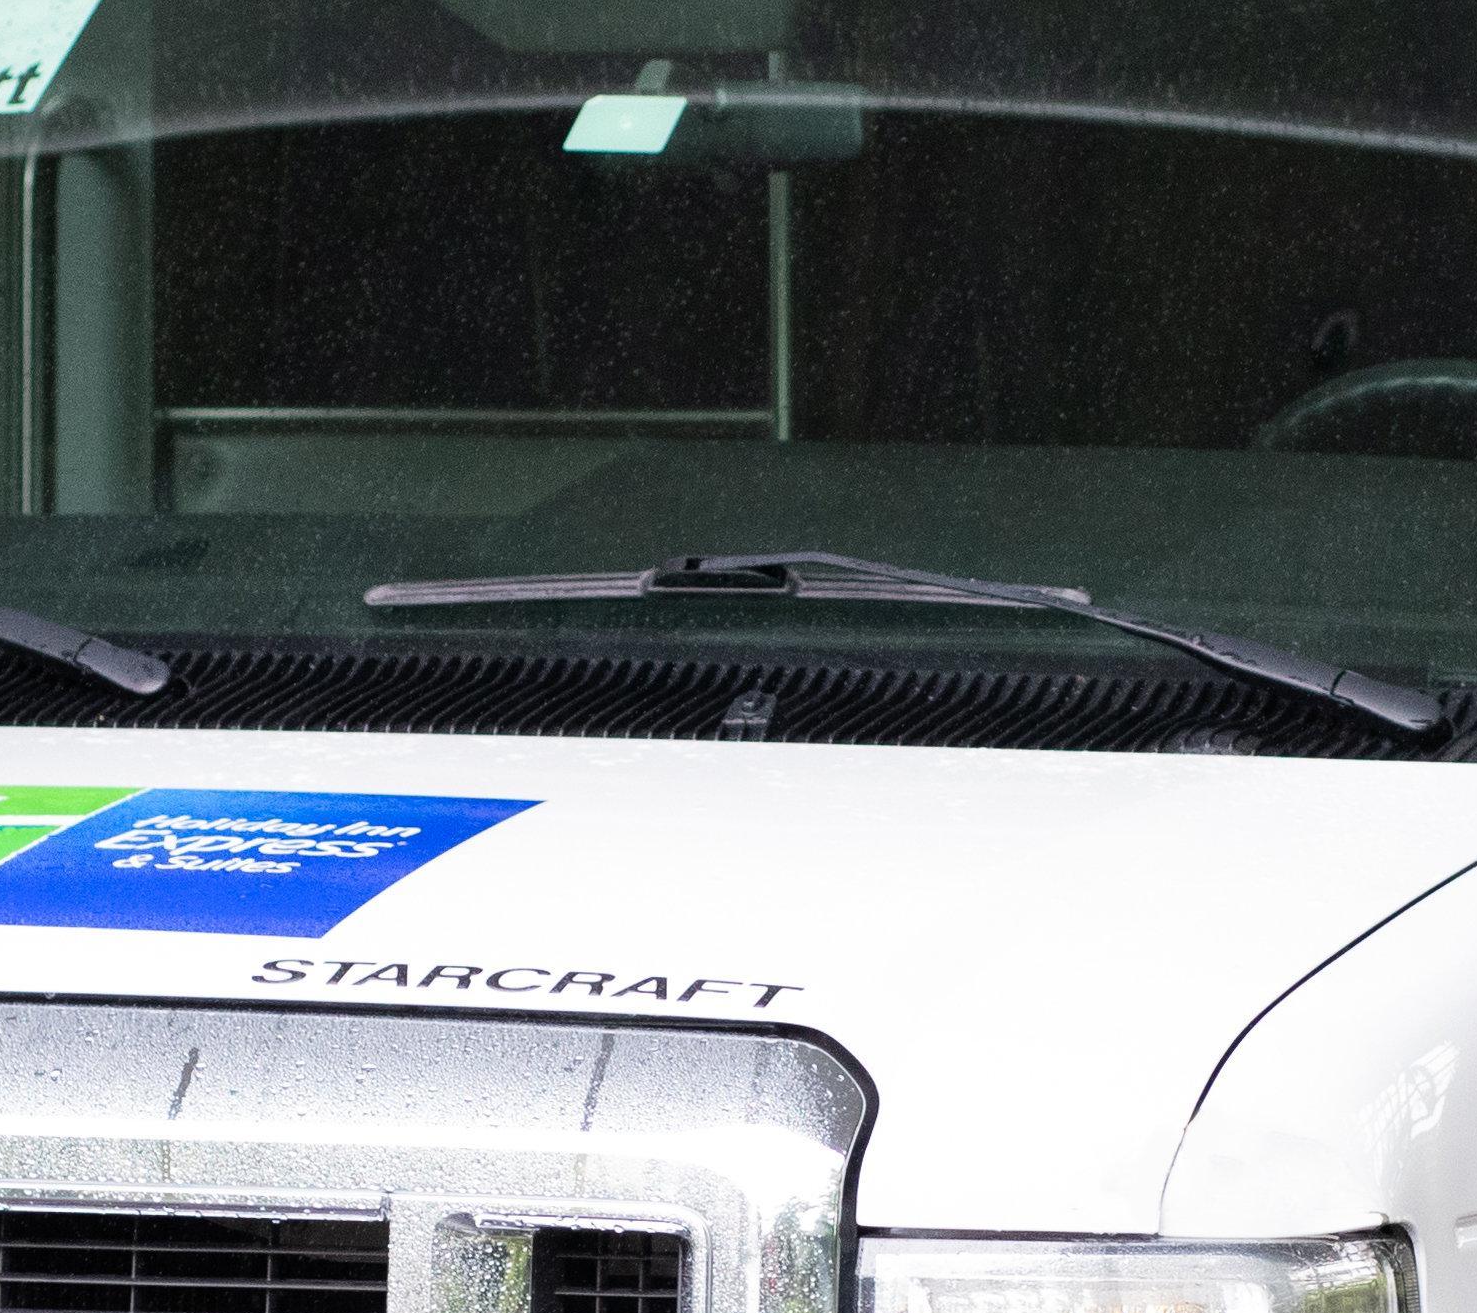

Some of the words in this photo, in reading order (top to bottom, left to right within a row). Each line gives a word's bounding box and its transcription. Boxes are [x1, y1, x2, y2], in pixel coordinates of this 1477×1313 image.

[133, 815, 337, 838] Holiday
[334, 820, 422, 838] Inn
[94, 829, 394, 858] Express
[112, 854, 155, 870] &
[155, 854, 302, 874] Suites
[251, 958, 805, 1009] STARCRAFT
